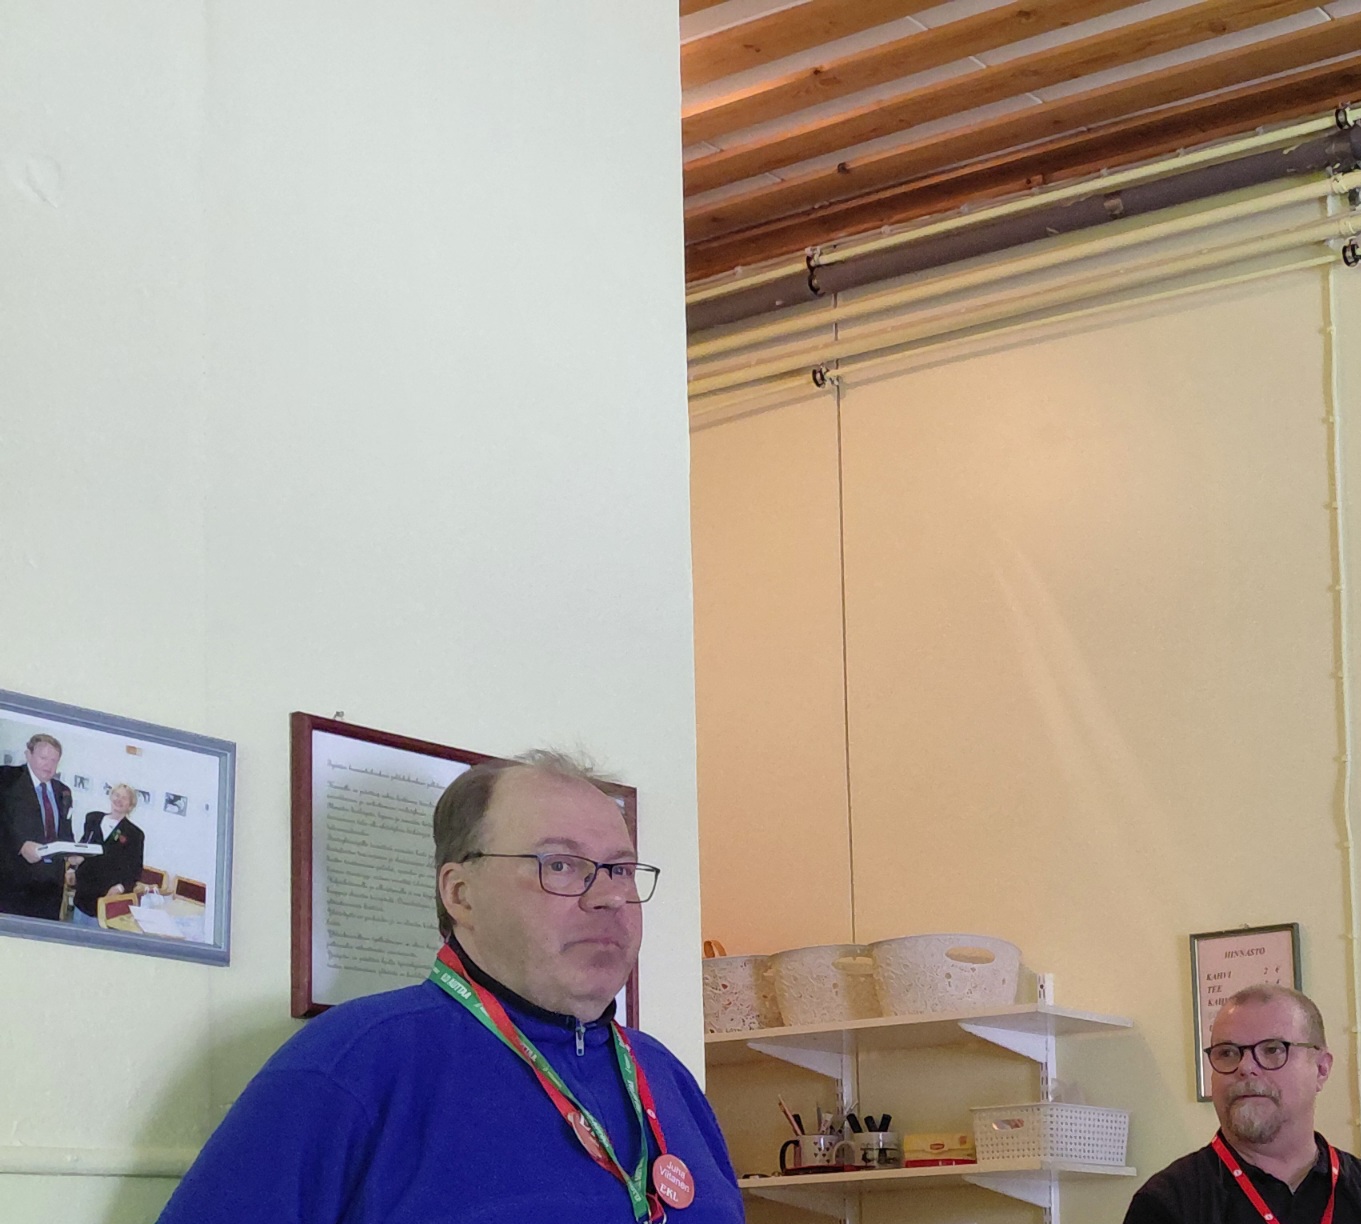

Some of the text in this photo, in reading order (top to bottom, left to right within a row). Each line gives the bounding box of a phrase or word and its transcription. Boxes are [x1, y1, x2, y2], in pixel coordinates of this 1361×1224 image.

[1224, 947, 1266, 959] HINNASTO
[1206, 970, 1232, 981] KAHVI
[1207, 985, 1223, 994] TEE
[660, 1183, 679, 1202] EKL
